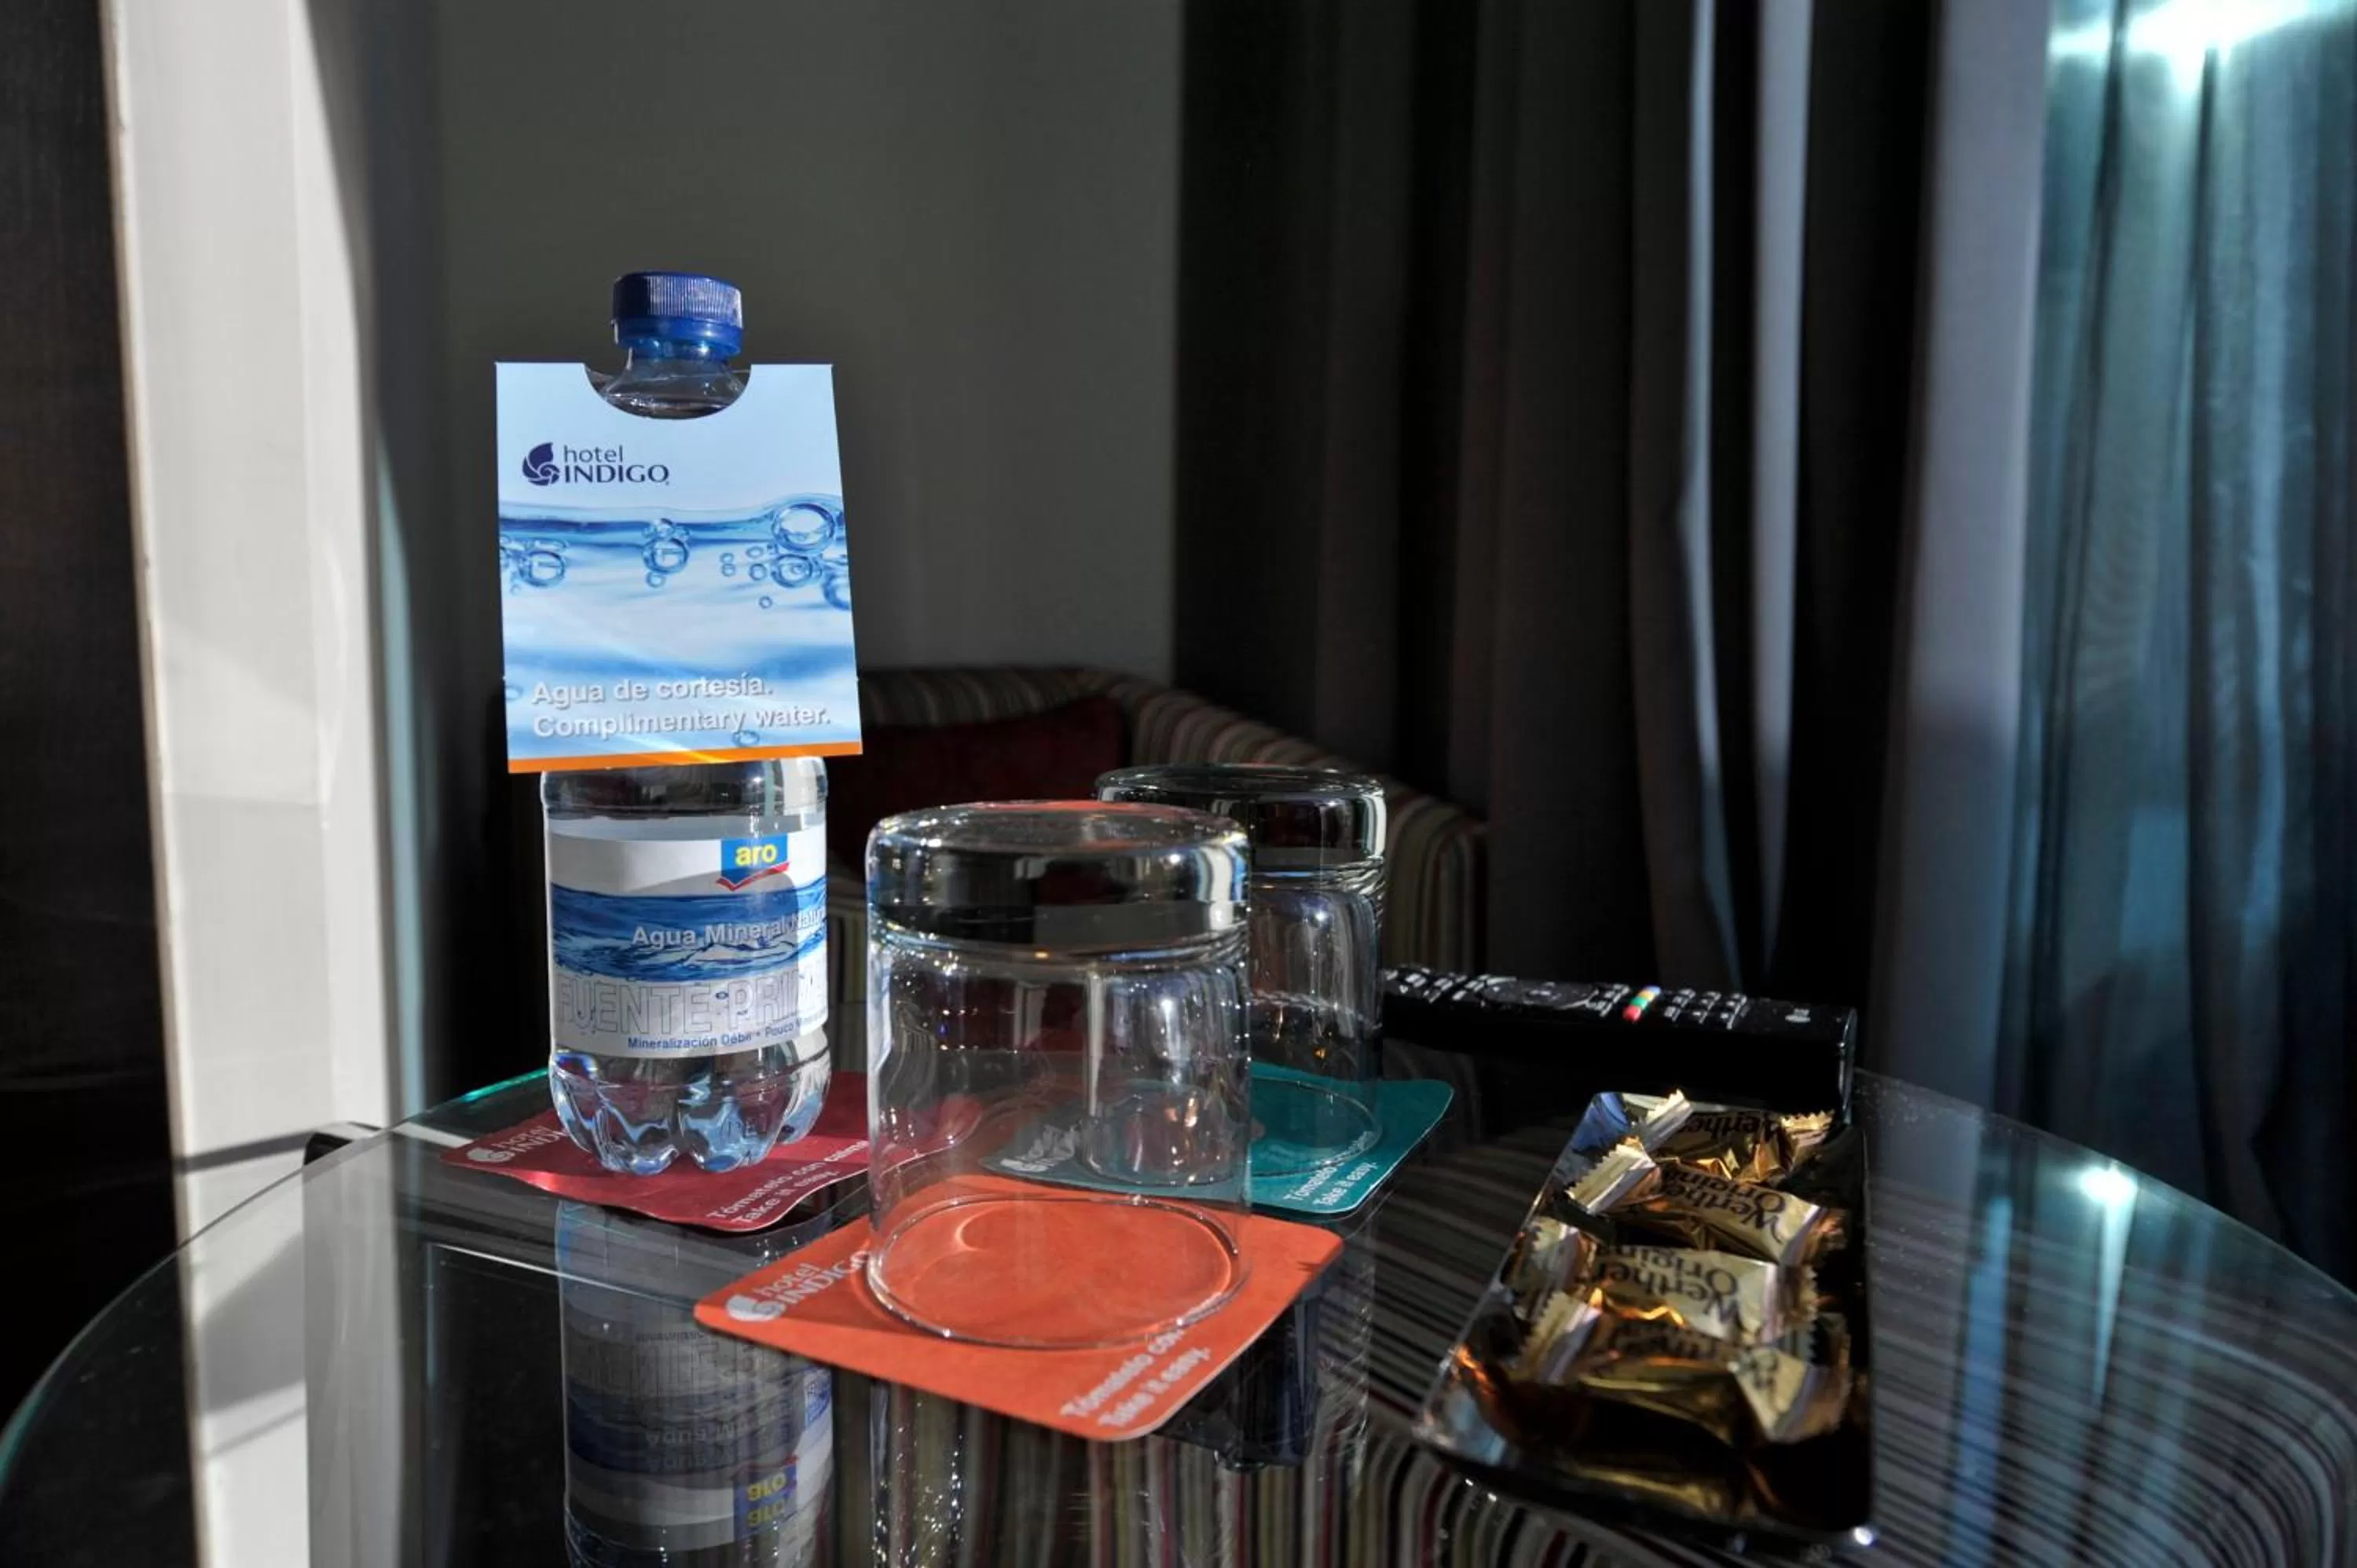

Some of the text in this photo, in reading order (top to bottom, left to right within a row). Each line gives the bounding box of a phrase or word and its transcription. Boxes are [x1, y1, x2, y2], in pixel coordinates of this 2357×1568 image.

[563, 445, 624, 463] hotel
[564, 464, 670, 484] INDIGO
[532, 672, 773, 709] Agua de cortesía.
[532, 705, 831, 740] Complimentary water.
[735, 843, 778, 865] aro
[631, 925, 697, 950] Agua
[704, 914, 786, 943] Mineral
[628, 1035, 717, 1049] Mineralización
[730, 1196, 779, 1222] Take
[753, 1262, 821, 1297] hotel
